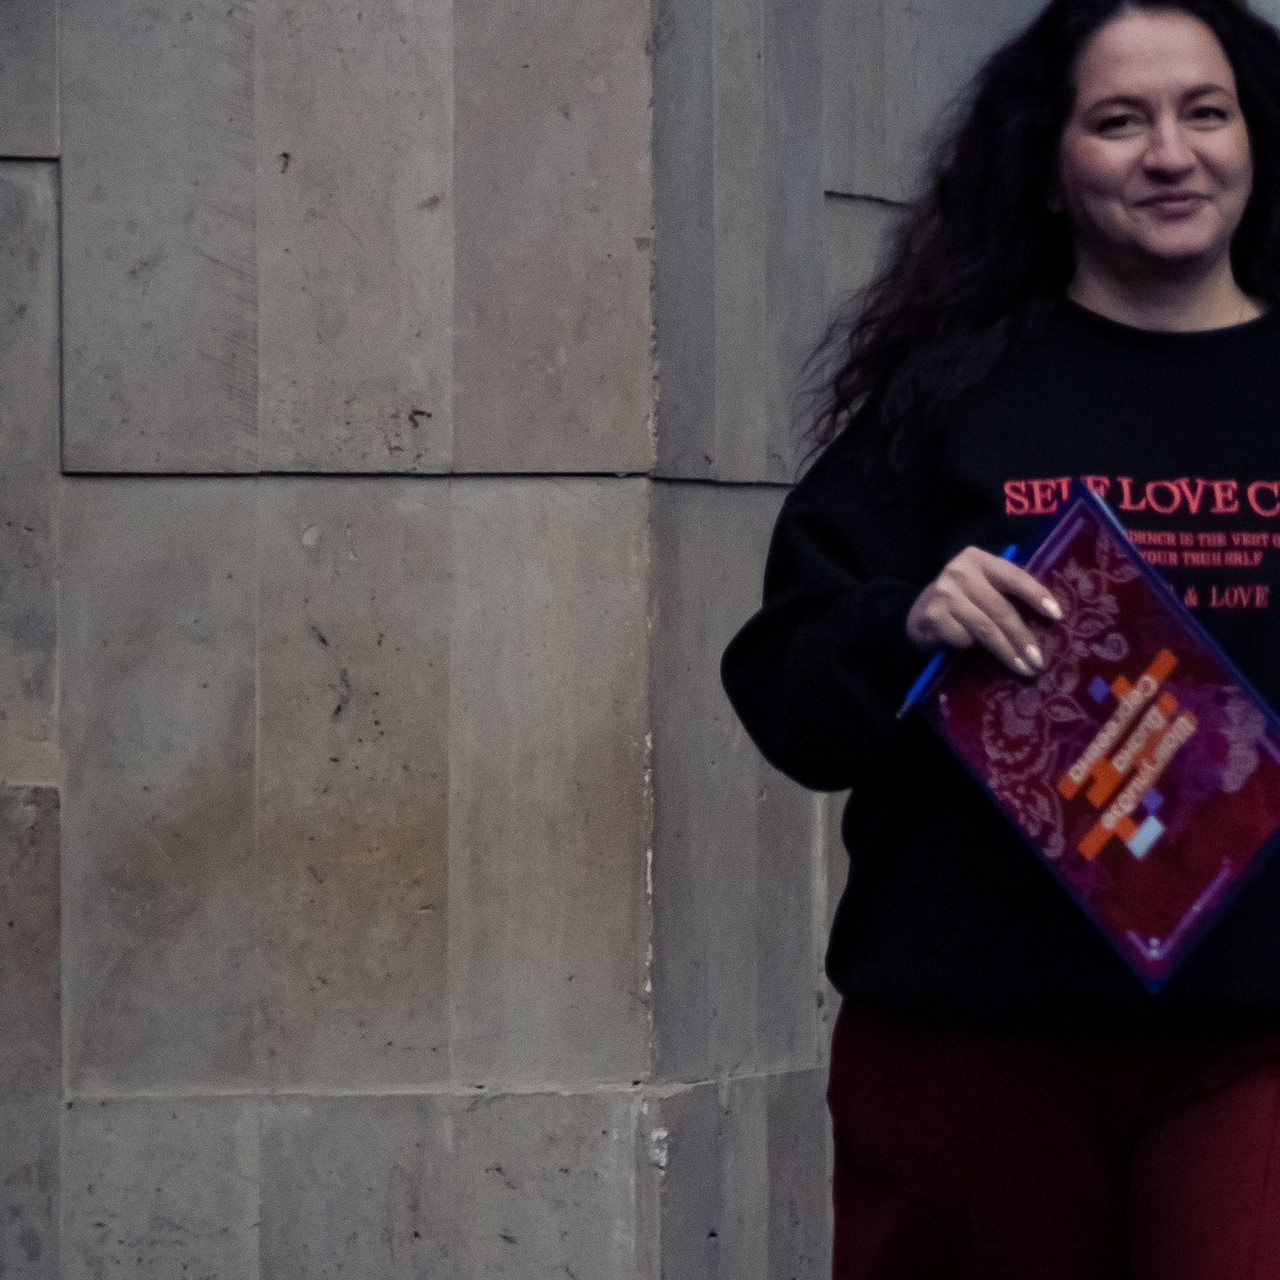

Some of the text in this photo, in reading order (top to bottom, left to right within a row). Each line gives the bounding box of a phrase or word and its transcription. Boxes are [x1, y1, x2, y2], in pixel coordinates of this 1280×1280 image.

[1115, 475, 1240, 516] LOVE
[1179, 531, 1195, 547] IS
[1197, 531, 1227, 547] THE
[1139, 550, 1178, 566] YOUR
[1184, 586, 1199, 608] &
[1210, 585, 1270, 608] LOVE
[1066, 674, 1159, 784] Сергеевна
[1110, 704, 1168, 774] Диана
